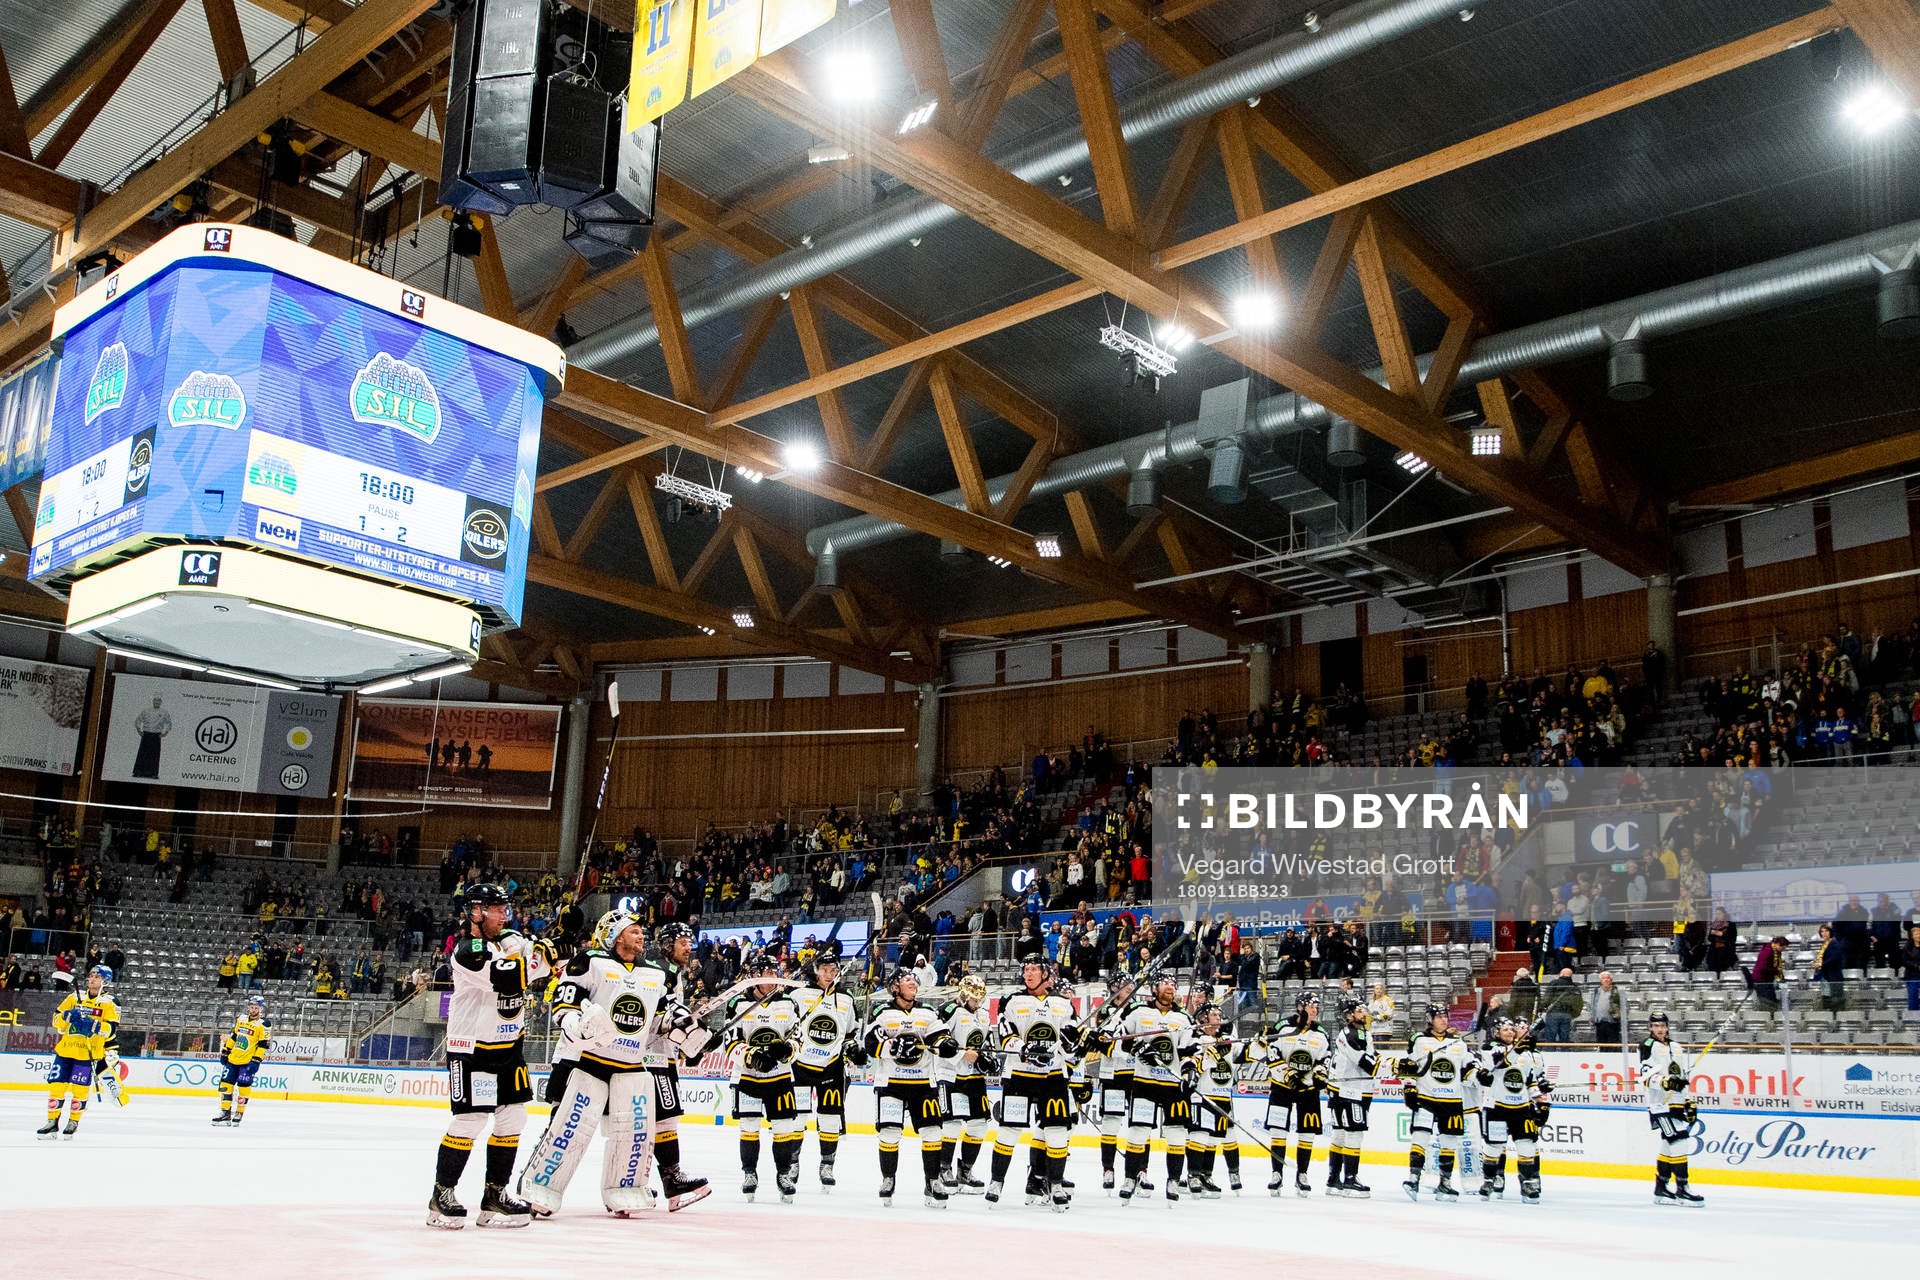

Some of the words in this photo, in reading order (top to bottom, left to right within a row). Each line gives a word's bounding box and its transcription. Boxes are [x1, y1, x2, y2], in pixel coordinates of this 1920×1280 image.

[82, 459, 107, 487] 18:00
[359, 472, 415, 505] 18:00
[368, 503, 400, 521] PAUSE
[359, 515, 366, 532] 1
[397, 526, 408, 543] 2
[466, 531, 507, 552] OILERS
[318, 529, 438, 571] SUPPORTER-UTSTYRET
[437, 560, 477, 582] KJØPES
[477, 571, 491, 586] PÅ
[353, 553, 458, 589] WWW.SIL.NO/WEBSHOP
[188, 575, 208, 584] AMFI
[19, 671, 55, 685] NORGES
[358, 705, 529, 726] KONFERANSEROM
[189, 753, 237, 765] CATERING
[181, 770, 240, 784] www.hai.no
[612, 1012, 644, 1027] OILERS
[809, 1029, 836, 1041] OILERS
[617, 1037, 641, 1049] STENA
[25, 1058, 52, 1072] Spa
[72, 1072, 88, 1083] eie
[312, 1070, 383, 1085] ARNKVÆRN
[1381, 1088, 1405, 1096] WÜR
[1843, 1083, 1912, 1096] Silkebækken
[1550, 1094, 1590, 1103] WÜRTH
[1611, 1094, 1645, 1103] WÜRT
[1690, 1096, 1720, 1105] ÜRTH
[1744, 1098, 1790, 1108] WÜRTH
[1815, 1099, 1864, 1110] WÜRTH
[632, 1095, 648, 1131] Sola
[534, 1149, 564, 1187] Sola
[553, 1092, 591, 1151] Betong
[1686, 1118, 1755, 1165] Bolig
[1756, 1119, 1876, 1161] Partner
[620, 1132, 648, 1188] Betong
